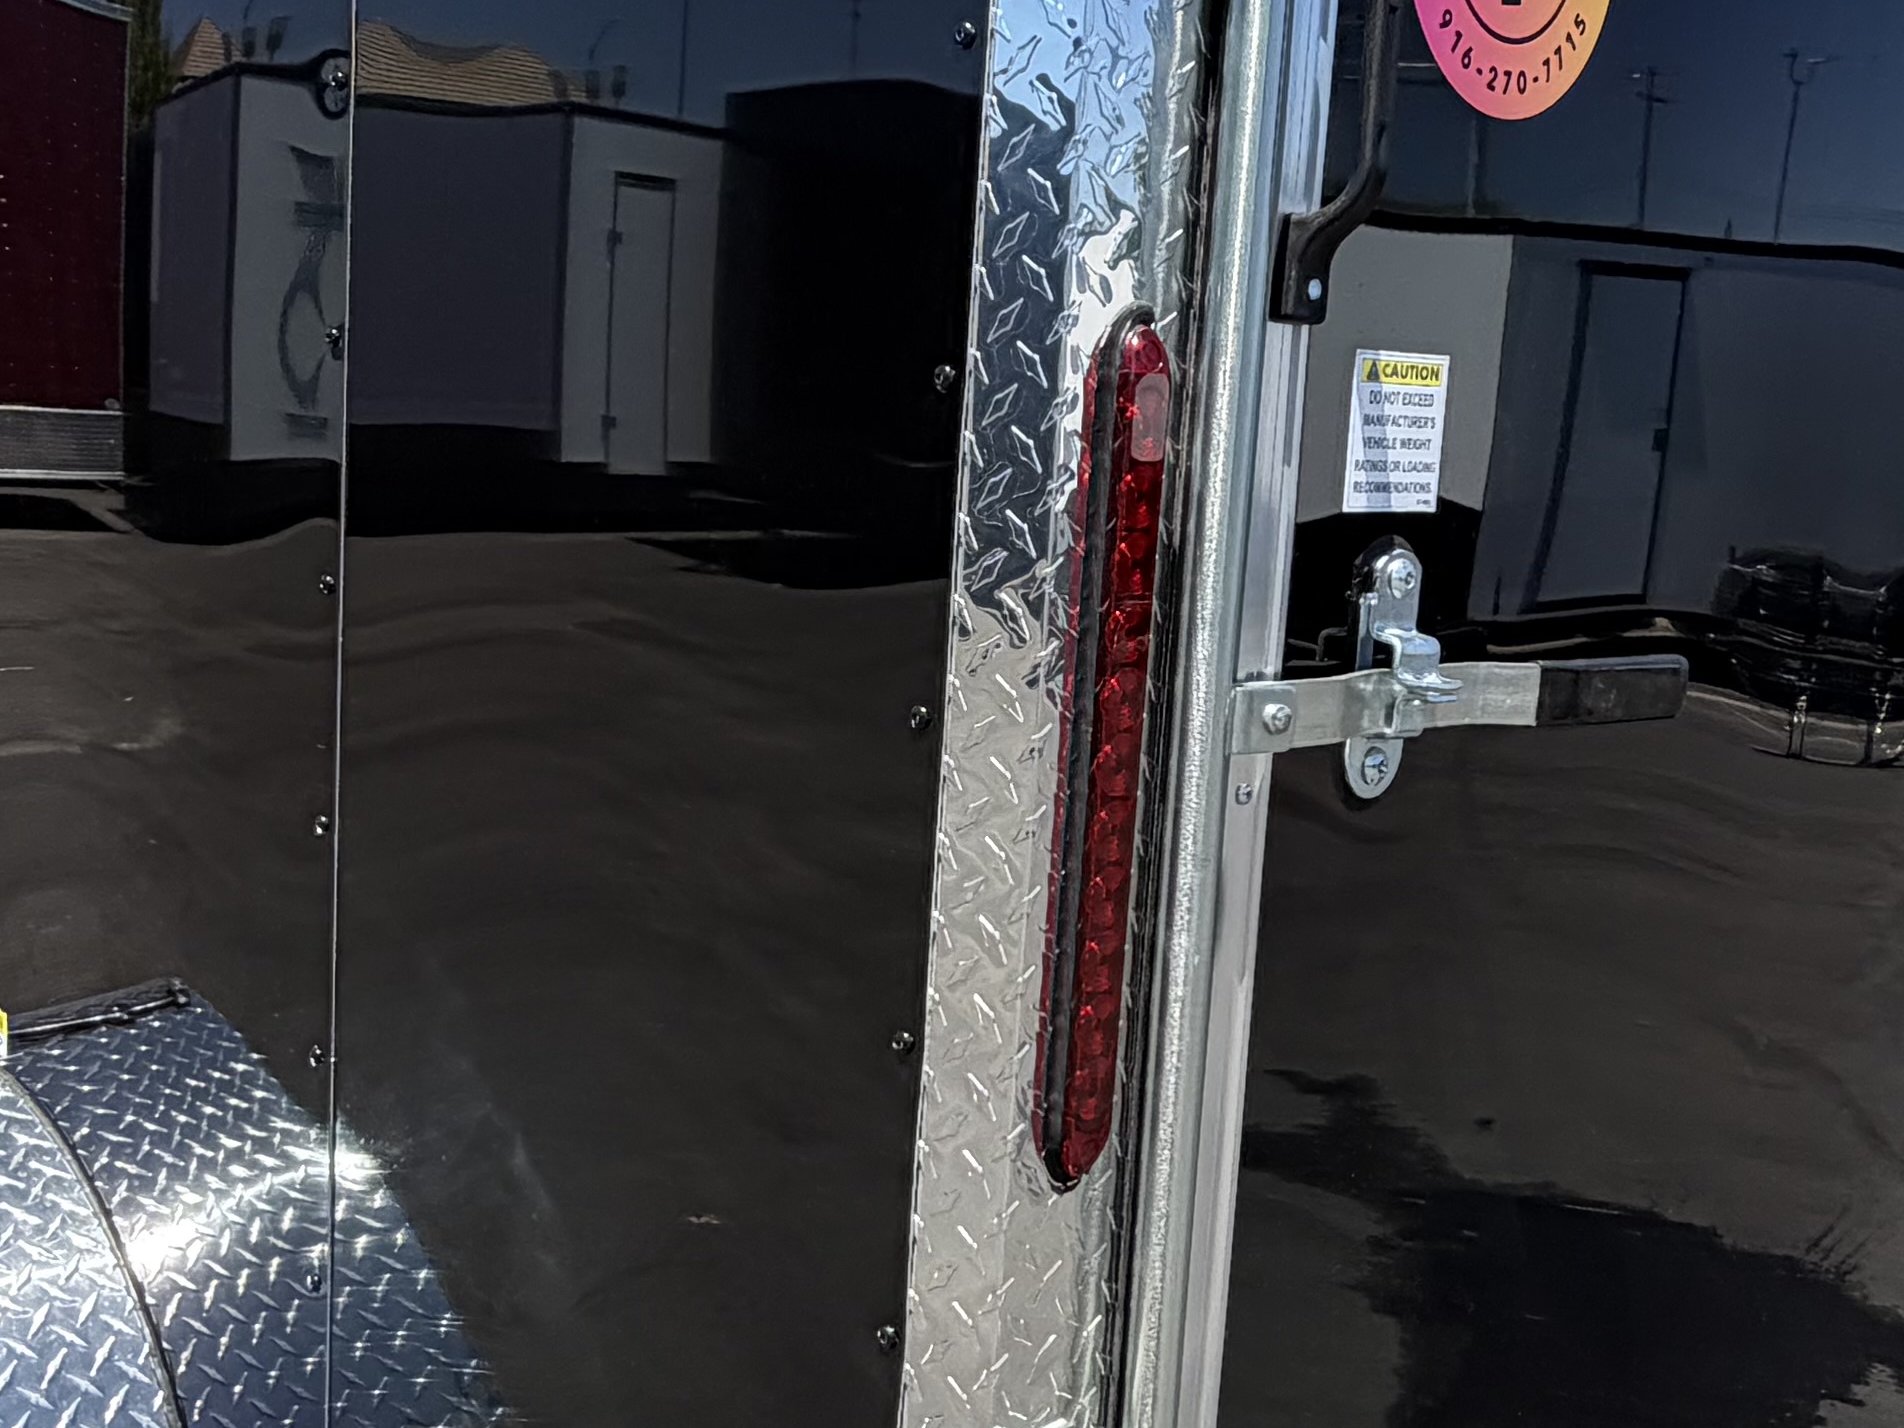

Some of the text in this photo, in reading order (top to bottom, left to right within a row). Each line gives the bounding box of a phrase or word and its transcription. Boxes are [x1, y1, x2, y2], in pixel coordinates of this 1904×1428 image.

[1439, 8, 1587, 96] 916-270-7715
[1382, 363, 1440, 381] CAUTION
[1369, 390, 1435, 407] DO NOT EXCEED
[1362, 436, 1432, 450] VEHICLE WEIGHT
[1354, 459, 1437, 473] RATINGS OR LOADING
